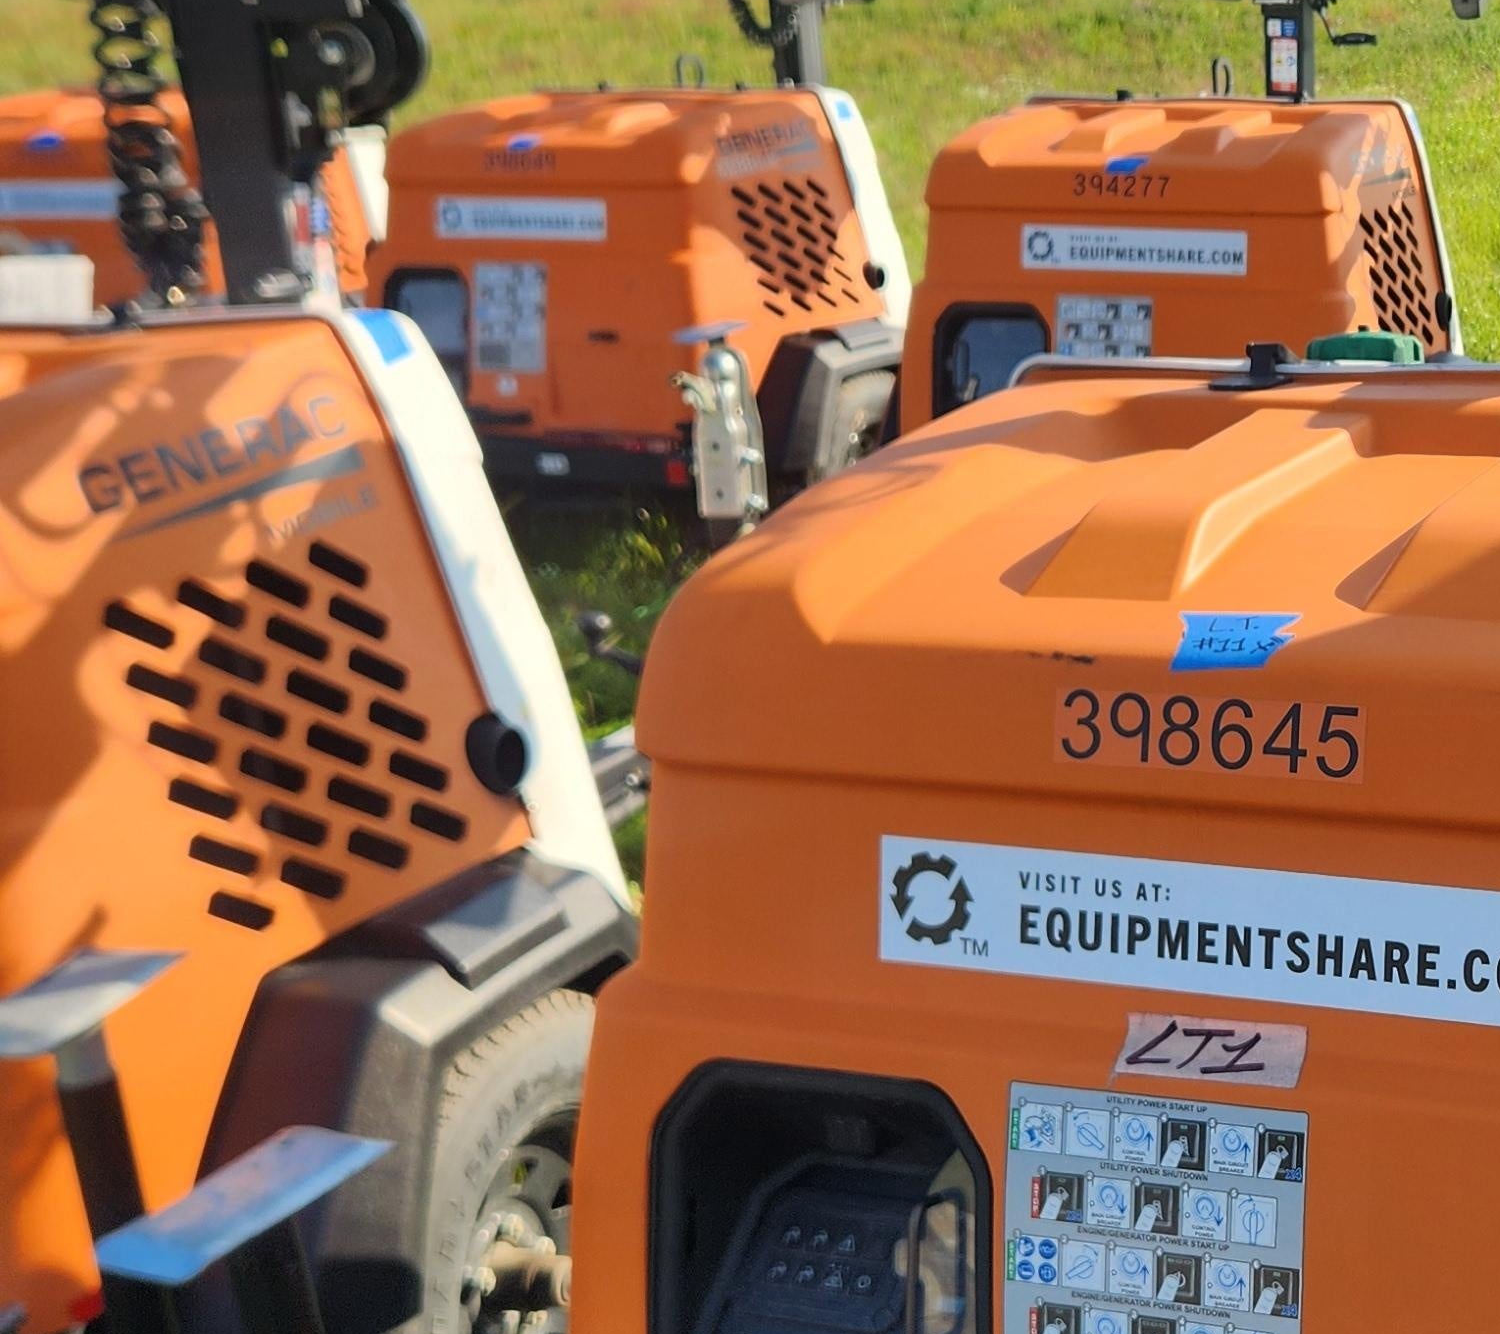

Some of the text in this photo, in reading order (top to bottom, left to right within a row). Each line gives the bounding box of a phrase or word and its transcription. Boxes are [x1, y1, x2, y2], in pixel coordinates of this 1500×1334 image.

[1073, 172, 1171, 198] 394277
[1069, 245, 1244, 266] EQUIPMENTSHARE.COM
[79, 396, 346, 514] GENERAC
[1062, 689, 1359, 778] 398645
[1019, 870, 1171, 903] VISIT US AT:
[960, 937, 989, 957] TM
[1106, 1095, 1208, 1113] UTILITY POWER START UP
[1100, 1162, 1208, 1181] UTILITY POWER SHUTDOWN
[1159, 1236, 1189, 1247] POWER
[1191, 1239, 1216, 1249] START
[1218, 1243, 1230, 1251] UP
[1153, 1302, 1182, 1312] POWER
[1184, 1305, 1231, 1319] SHUTDOWN
